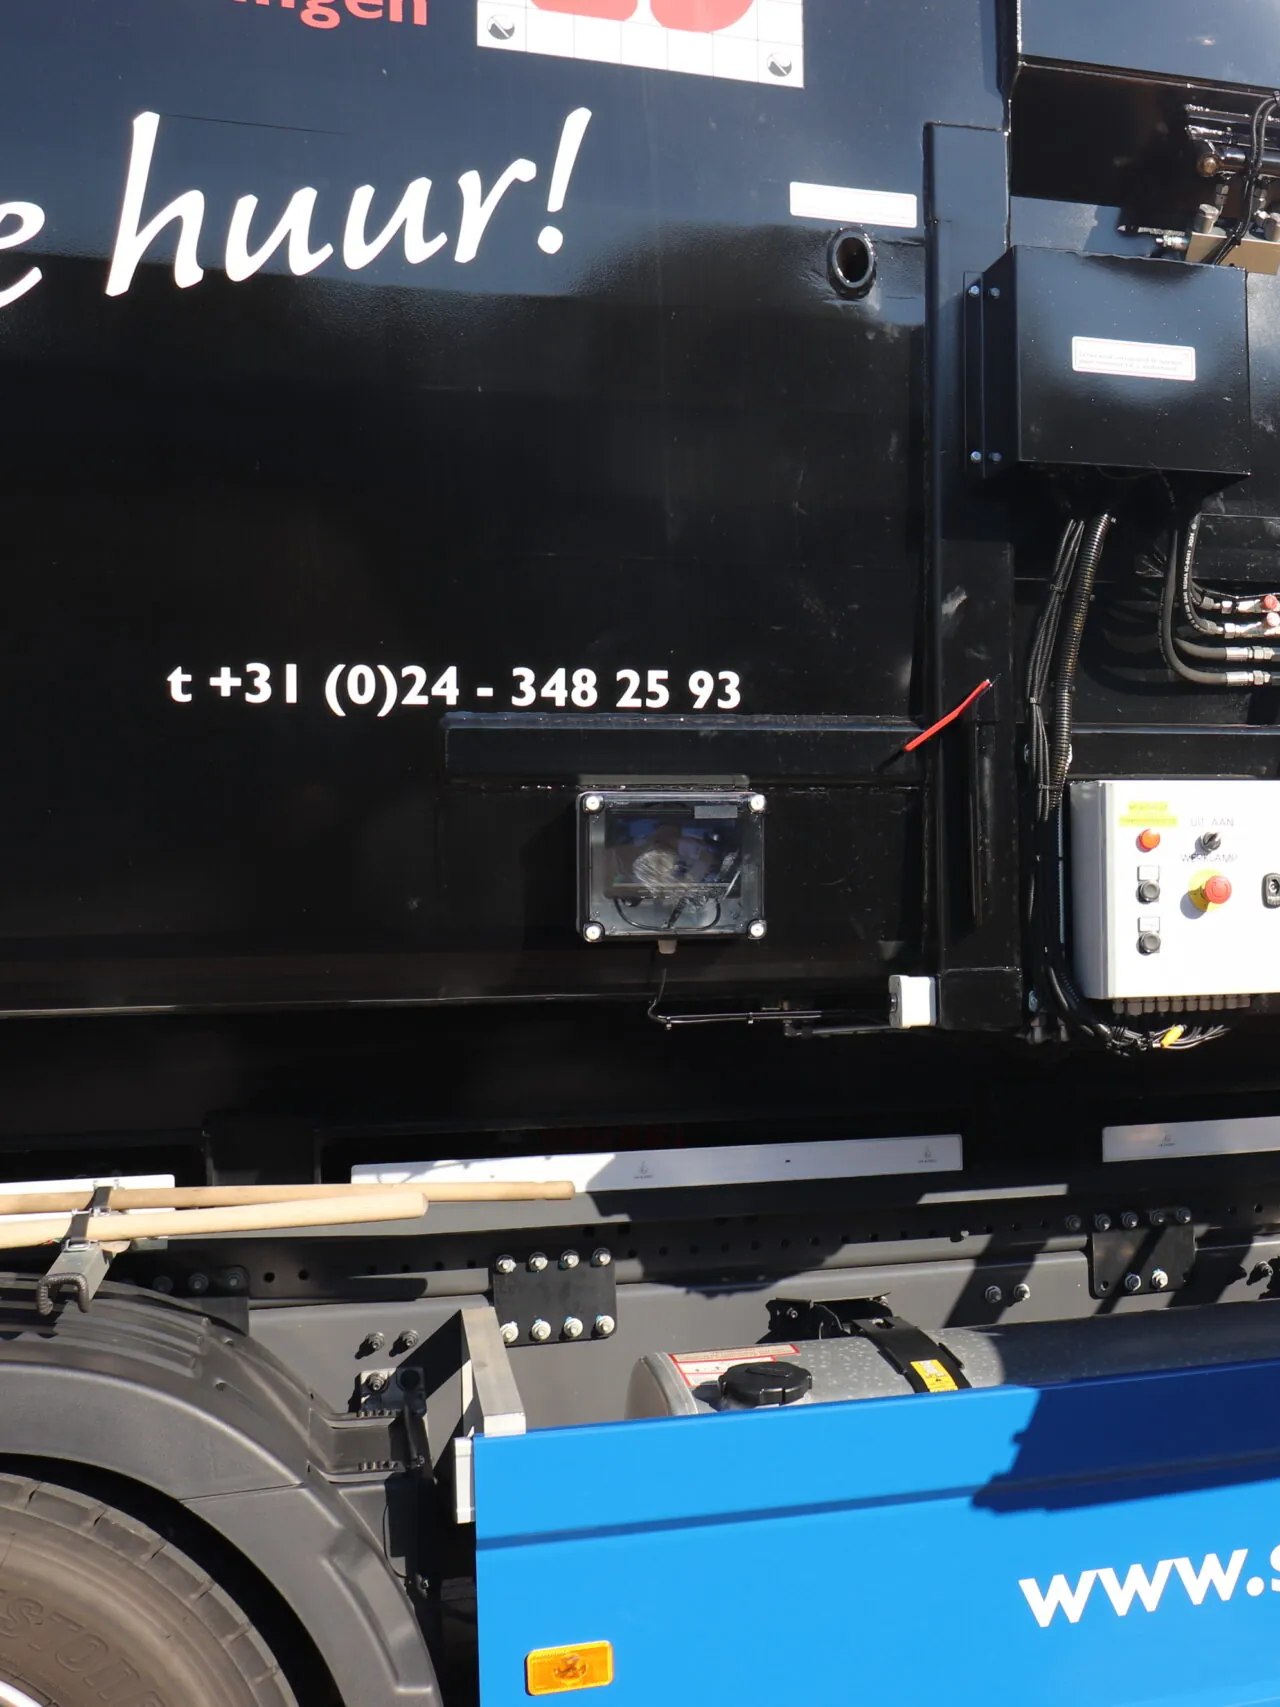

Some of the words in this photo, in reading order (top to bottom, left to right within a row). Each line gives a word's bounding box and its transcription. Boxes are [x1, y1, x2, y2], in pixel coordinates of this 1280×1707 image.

[105, 106, 593, 297] huur!
[166, 665, 193, 703] t
[209, 662, 298, 704] +31
[324, 663, 460, 717] (0)24
[476, 687, 494, 697] -
[511, 666, 598, 708] 348
[615, 668, 670, 709] 25
[688, 670, 741, 709] 93
[1190, 816, 1204, 827] UIT
[1210, 816, 1235, 827] AAN
